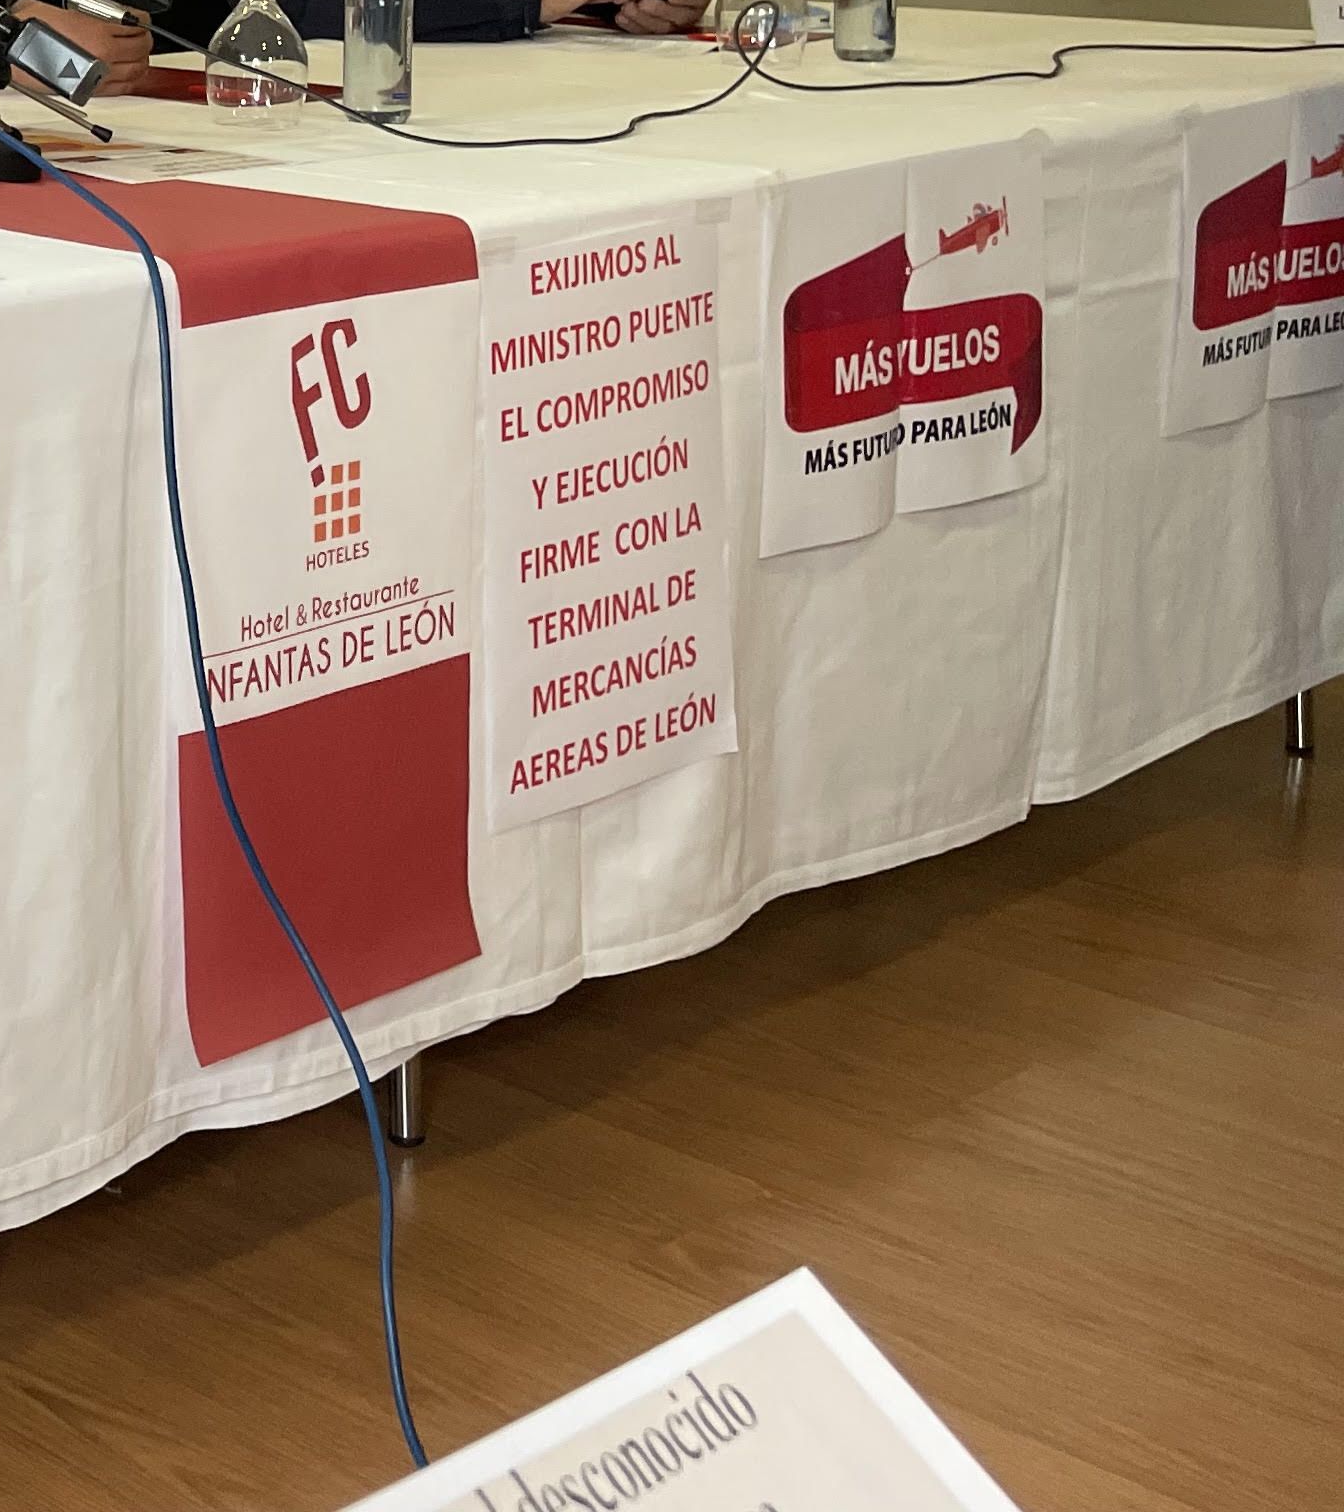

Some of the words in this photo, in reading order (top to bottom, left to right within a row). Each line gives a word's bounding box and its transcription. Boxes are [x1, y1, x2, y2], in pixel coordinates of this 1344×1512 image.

[529, 240, 648, 296] EXIJIMOS
[653, 233, 681, 270] AL
[1226, 250, 1271, 299] MÁS
[1273, 241, 1344, 285] UELO
[490, 315, 622, 376] MINISTRO
[629, 291, 714, 343] PUENTE
[834, 339, 894, 397] MÁS
[1202, 336, 1234, 367] MÁS
[1276, 316, 1321, 341] PARA
[500, 406, 529, 443] EL
[536, 359, 710, 433] COMPROMISO
[804, 439, 850, 476] MÁS
[911, 414, 968, 445] PARA
[969, 401, 1012, 436] LEÓN
[531, 475, 549, 510] Y
[556, 434, 689, 505] EJECUCIÓN
[304, 540, 371, 573] HOTELES
[520, 530, 601, 584] FIRME
[614, 511, 668, 556] CON
[675, 501, 702, 539] LA
[240, 604, 289, 642] Hotel
[296, 602, 309, 627] &
[312, 575, 420, 623] Restaurante
[527, 582, 661, 650] TERMINAL
[667, 568, 697, 608] DE
[207, 637, 332, 704] NFANTAS
[342, 623, 375, 669] DE
[385, 599, 455, 656] LEÓN
[531, 635, 698, 718] MERCANCÍAS
[510, 730, 609, 795] AEREAS
[616, 717, 647, 757] DE
[654, 691, 717, 745] LEÓN
